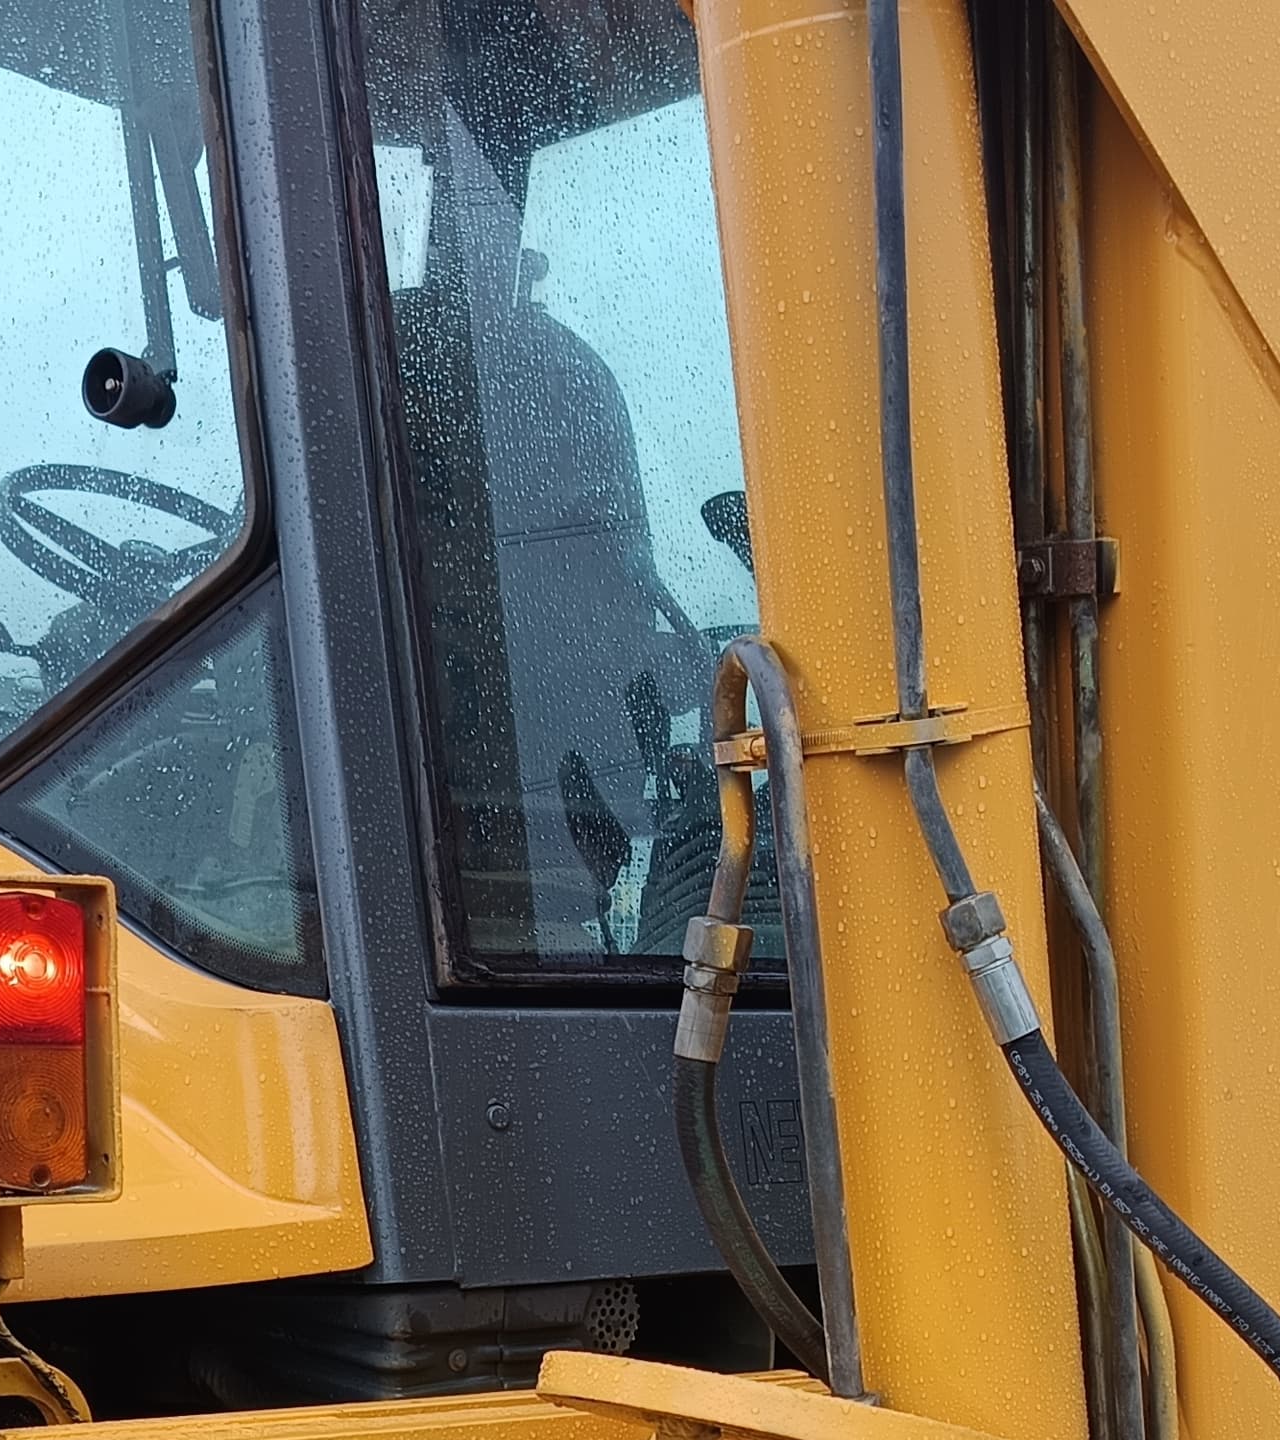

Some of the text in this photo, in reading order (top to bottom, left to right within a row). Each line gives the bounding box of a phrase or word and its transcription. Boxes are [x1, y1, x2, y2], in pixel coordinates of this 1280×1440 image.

[739, 1099, 803, 1185] NE
[1148, 1235, 1169, 1255] SAE
[1231, 1314, 1250, 1332] ISO
